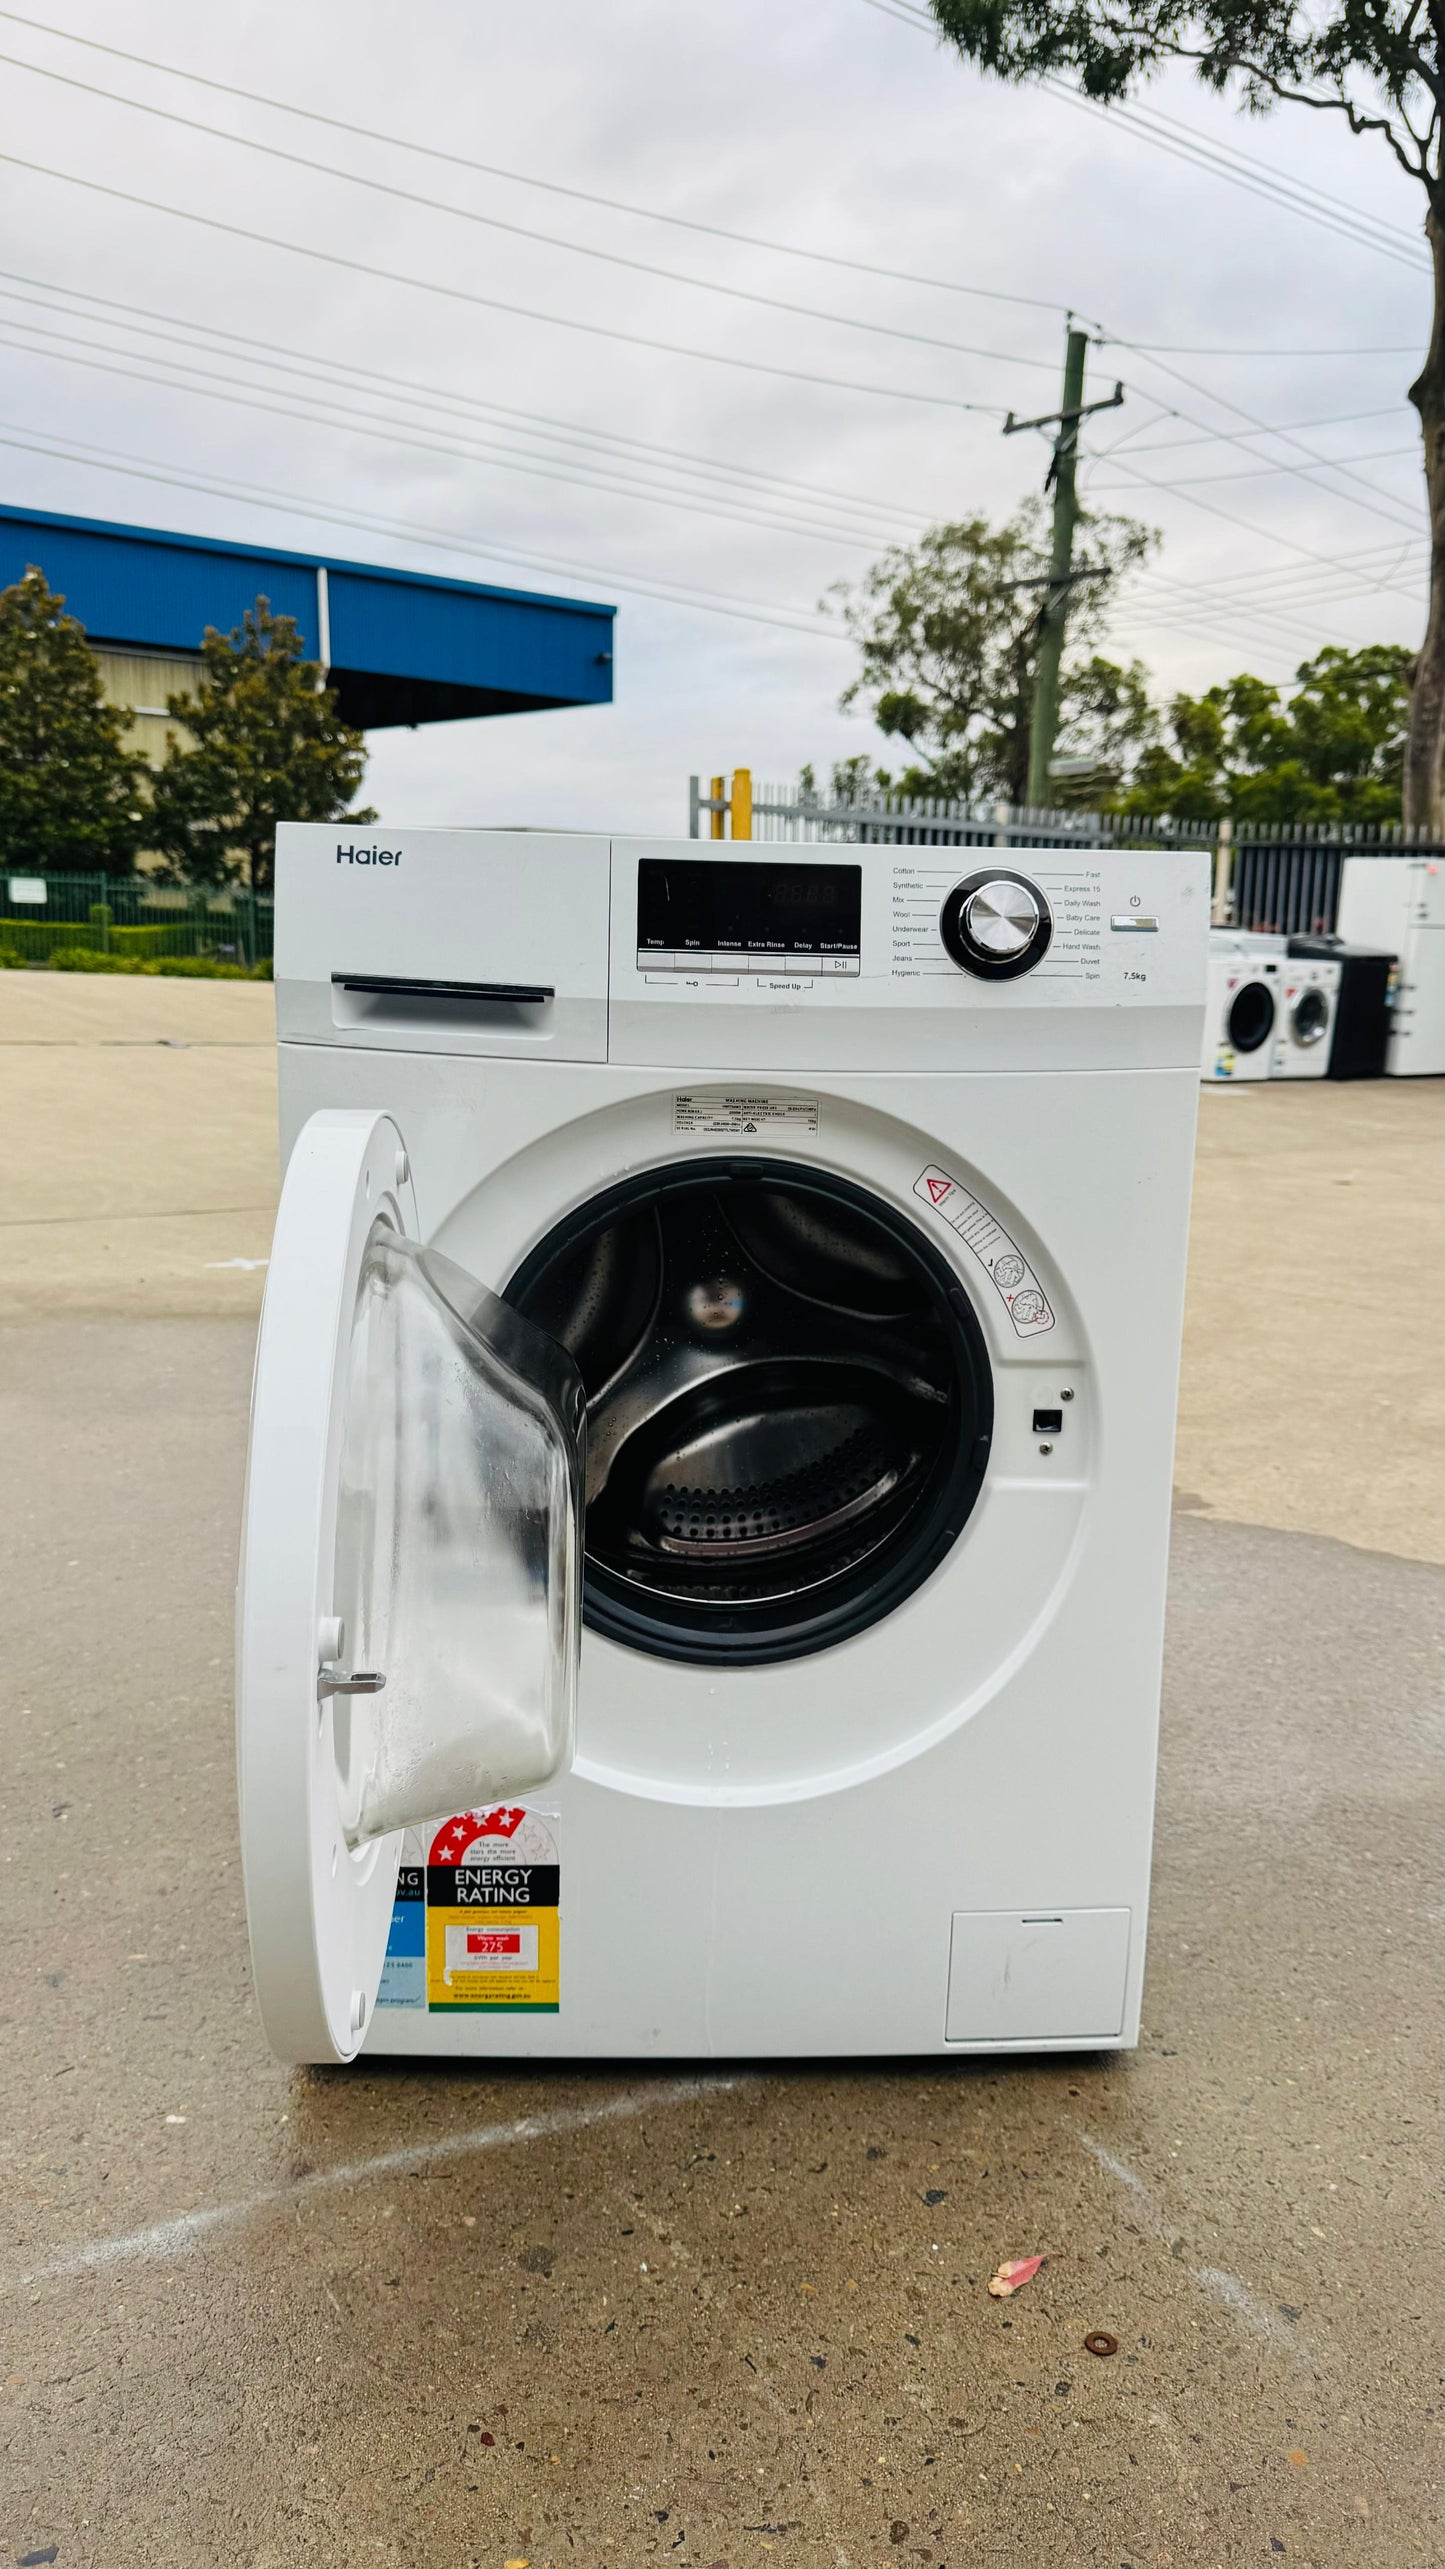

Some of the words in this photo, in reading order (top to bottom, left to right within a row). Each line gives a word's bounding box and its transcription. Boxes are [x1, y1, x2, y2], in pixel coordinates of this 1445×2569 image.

[336, 845, 402, 866] Haier
[893, 867, 915, 875] Cotton
[893, 882, 923, 890] Synthetic
[1064, 885, 1090, 893] Express
[892, 896, 905, 904] Mix
[1064, 900, 1081, 908] Daily
[1066, 914, 1083, 922] Baby
[892, 925, 929, 933] Underwear
[647, 938, 664, 946] Temp
[794, 942, 812, 950] Delay
[892, 940, 911, 948] Sport
[892, 969, 921, 978] Hygienic
[1085, 972, 1100, 980] Spin
[1123, 972, 1146, 982] 7.5kg
[770, 982, 790, 990] Speed
[455, 1869, 532, 1885] ENERGY
[457, 1888, 530, 1903] RATING
[481, 1942, 504, 1952] 275
